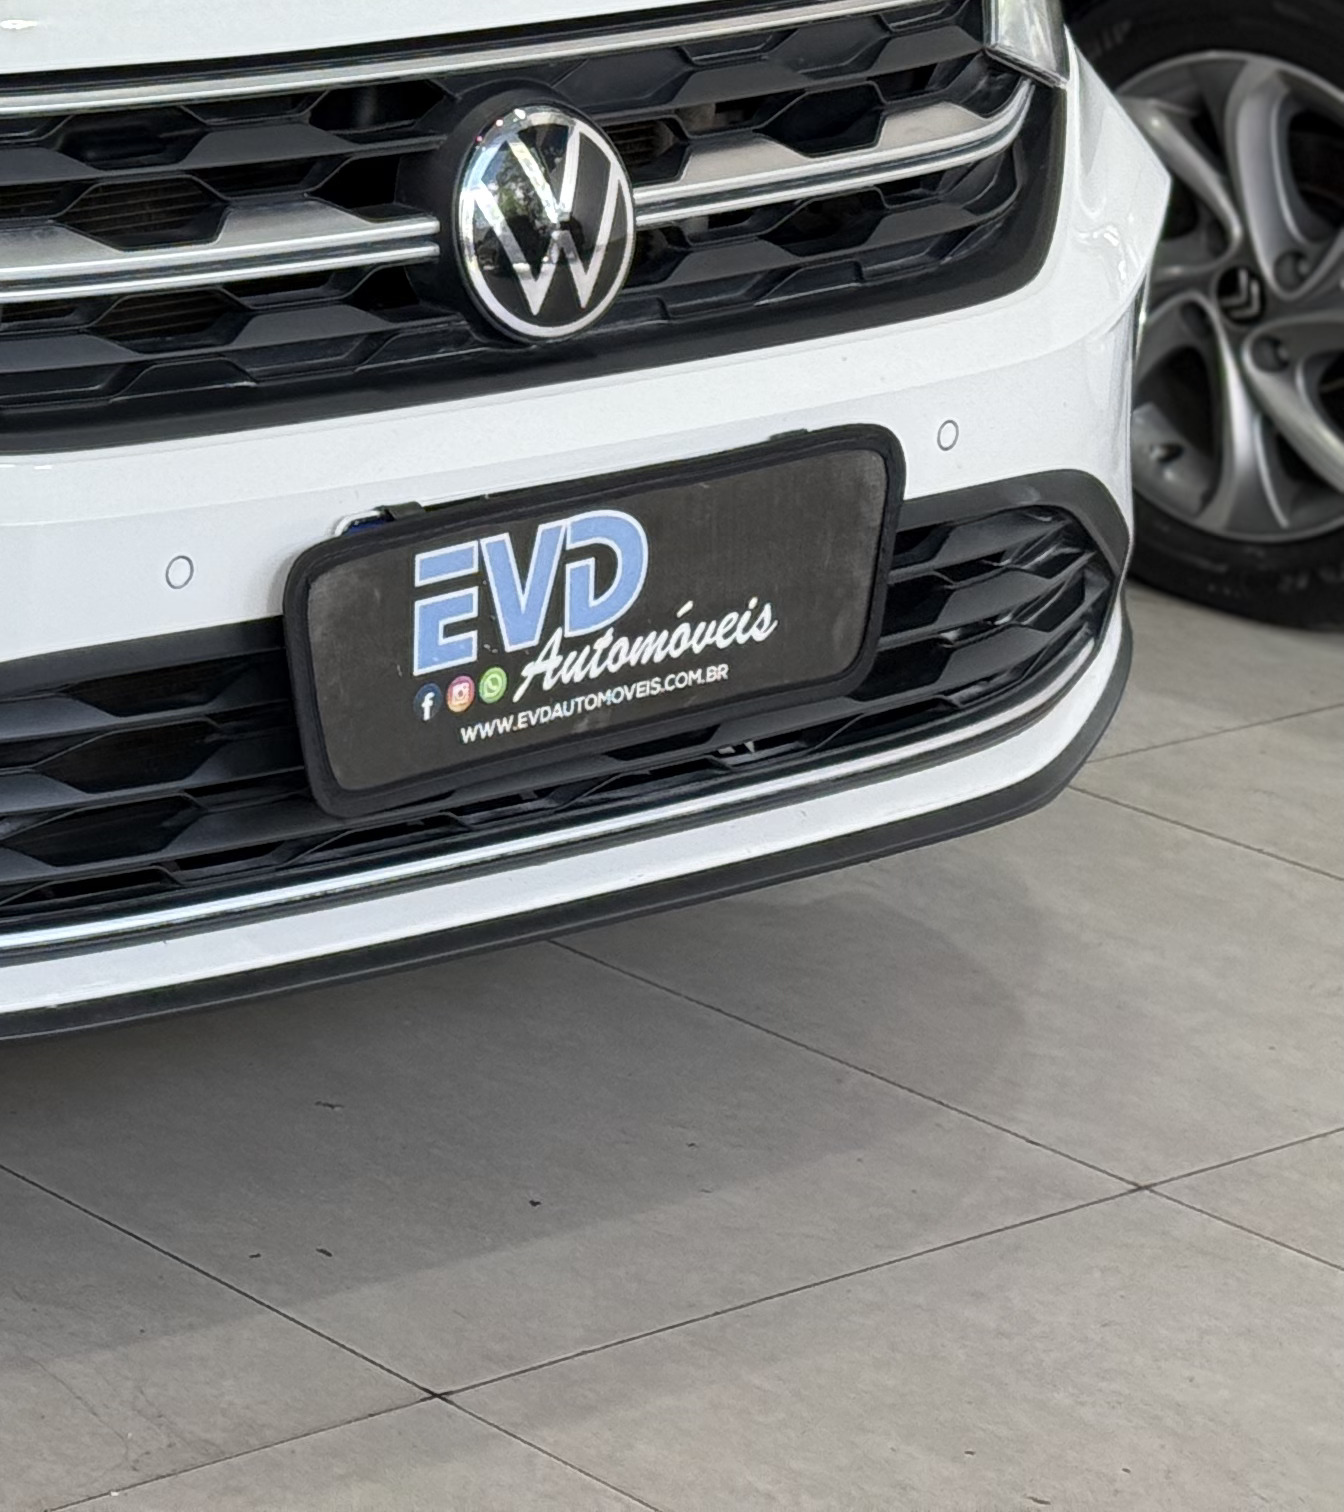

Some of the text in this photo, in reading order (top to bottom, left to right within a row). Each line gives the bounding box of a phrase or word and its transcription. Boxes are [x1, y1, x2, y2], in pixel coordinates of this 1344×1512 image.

[413, 509, 648, 676] EVD
[513, 597, 778, 703] Automóveis
[460, 663, 729, 744] WWW.EVDAUTOMOVEIS.COM.BR
